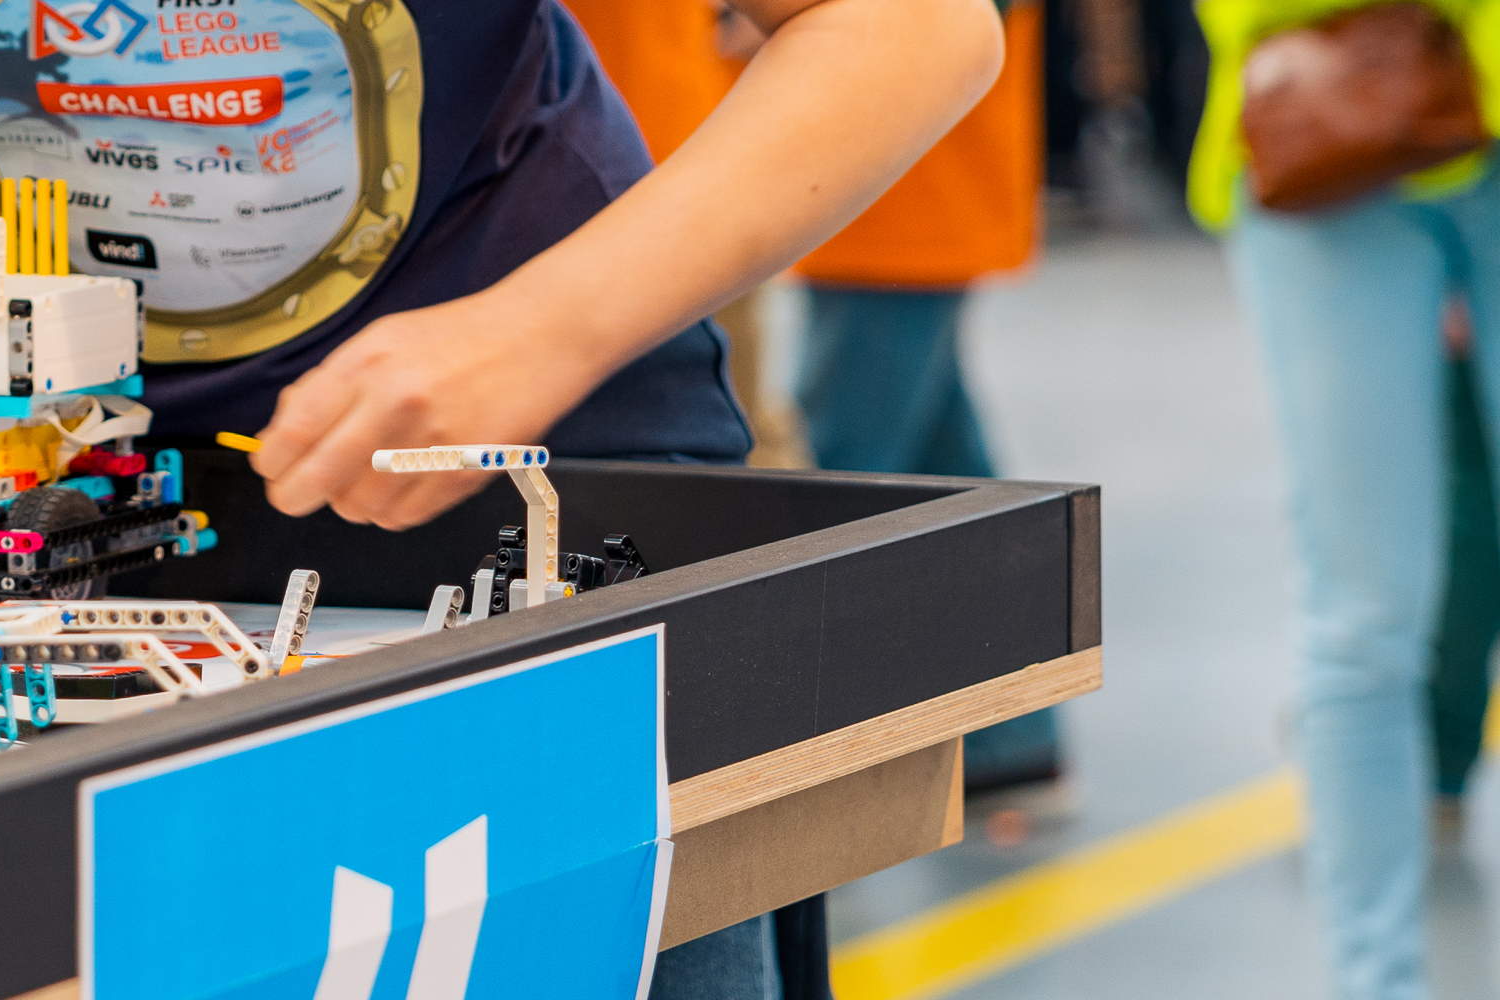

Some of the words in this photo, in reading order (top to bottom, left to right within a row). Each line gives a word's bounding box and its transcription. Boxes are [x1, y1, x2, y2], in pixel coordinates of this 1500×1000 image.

[157, 11, 239, 35] LEGO
[161, 31, 281, 61] LEAGUE
[58, 88, 263, 119] CHALLENGE
